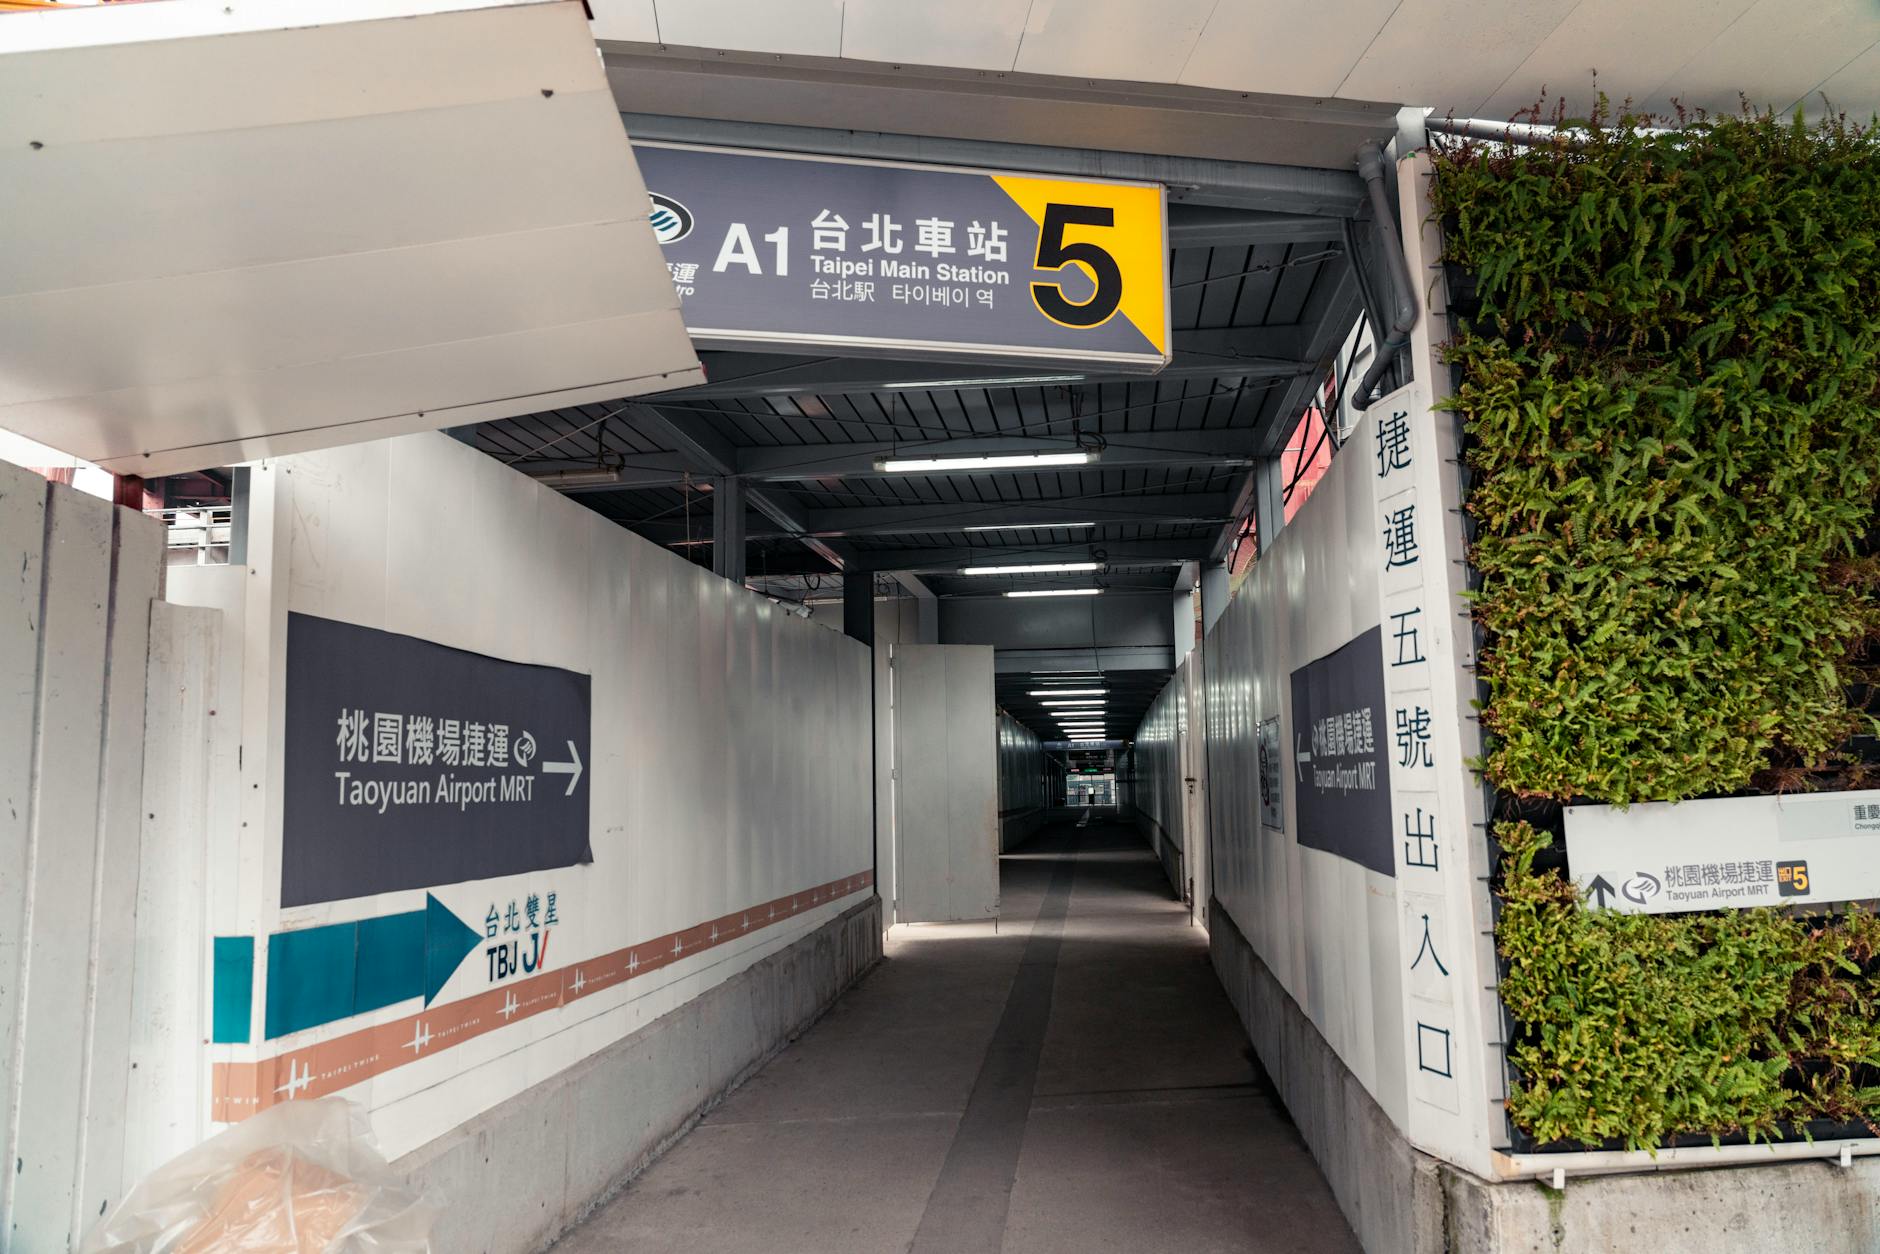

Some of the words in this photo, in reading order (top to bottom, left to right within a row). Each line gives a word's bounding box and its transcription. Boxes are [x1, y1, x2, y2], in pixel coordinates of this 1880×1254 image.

[712, 222, 789, 277] A1
[811, 208, 1009, 262] 台北車站
[810, 255, 873, 279] Taipei
[880, 260, 930, 280] Main
[936, 263, 1010, 285] Station
[1031, 202, 1122, 329] 5
[810, 278, 875, 302] 台北駅
[892, 283, 969, 308] 타이베이
[976, 289, 993, 309] 역
[336, 708, 509, 768] 桃園機場捷運
[1376, 411, 1452, 1078] 捷運五號出入口
[335, 772, 430, 814] Taoyuan
[435, 773, 496, 811] Airport
[500, 775, 535, 802] MRT
[1336, 762, 1358, 797] Airport
[1358, 761, 1376, 790] MRT
[1664, 860, 1774, 888] 桃園機場捷運
[1666, 889, 1709, 902] Taoyuan
[1712, 887, 1745, 899] Airport
[1747, 884, 1769, 896] MRT
[1793, 866, 1809, 891] 5
[486, 893, 559, 939] 台北雙星
[487, 941, 518, 982] TBJ
[321, 1064, 352, 1081] TAIPEI
